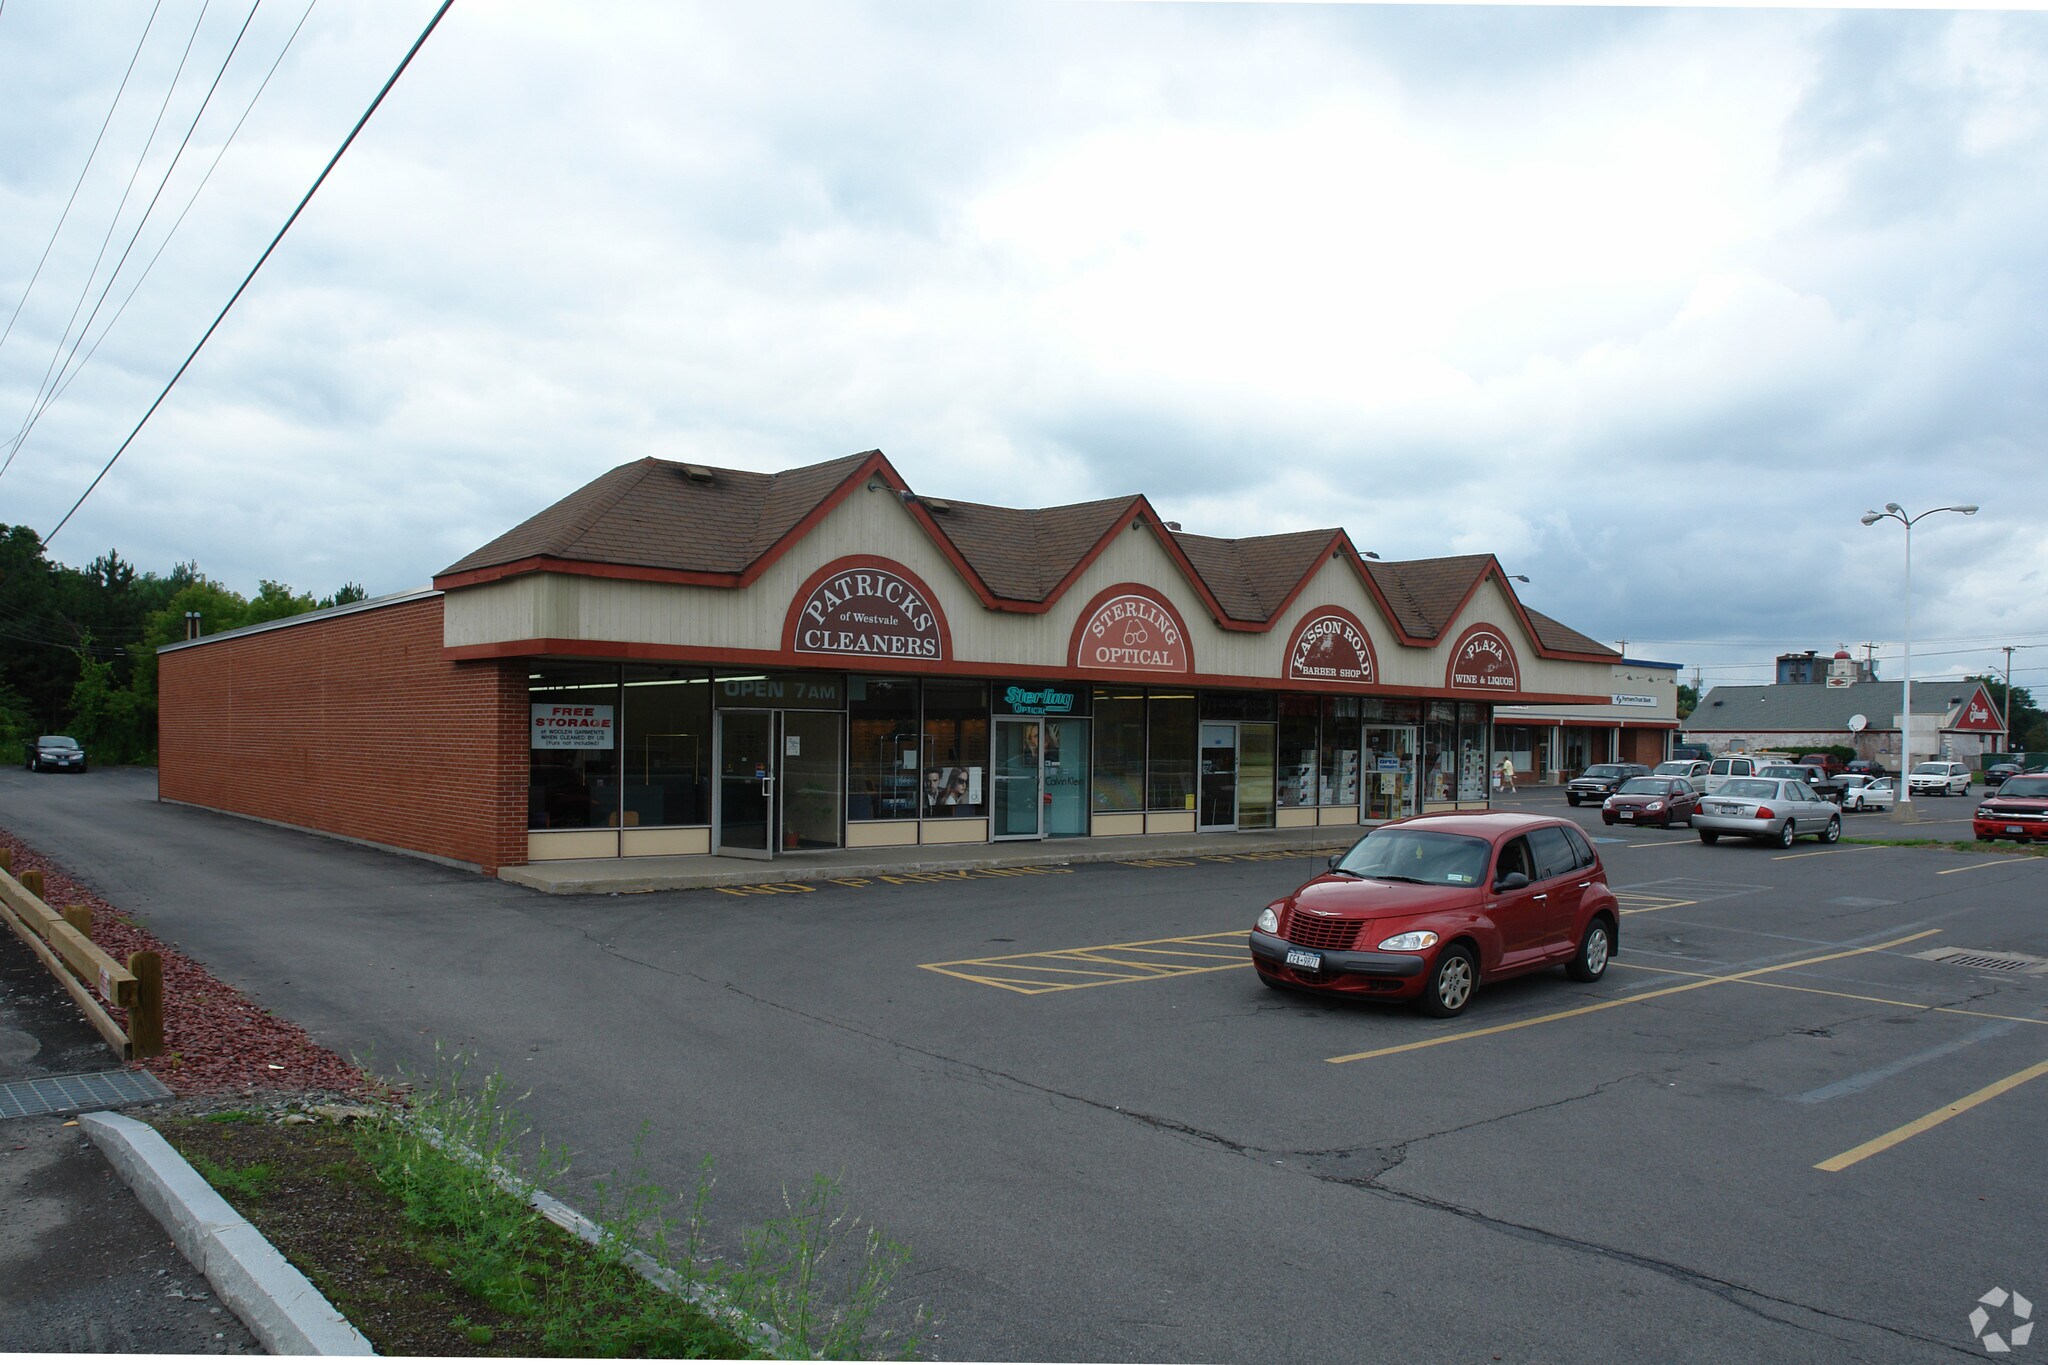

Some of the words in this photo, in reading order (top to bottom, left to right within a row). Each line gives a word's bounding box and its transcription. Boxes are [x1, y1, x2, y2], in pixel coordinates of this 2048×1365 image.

[806, 574, 933, 632] PATRICKS
[840, 612, 851, 621] of
[852, 612, 899, 626] Westvale
[1092, 601, 1178, 646] STERLING
[804, 629, 936, 656] CLEANERS
[1293, 621, 1342, 670] KASSON
[1343, 626, 1370, 675] ROAD
[1466, 639, 1503, 662] PLAZA
[1095, 646, 1174, 666] OPTICAL
[1302, 666, 1337, 677] BARBER
[1339, 668, 1361, 678] SHOP
[1455, 673, 1478, 684] WINE
[1479, 675, 1486, 684] &
[1487, 676, 1514, 686] LIQUOR
[724, 680, 785, 698] OPEN
[1005, 686, 1074, 712] Sterling
[552, 707, 595, 716] FREE
[535, 717, 612, 728] STORAGE
